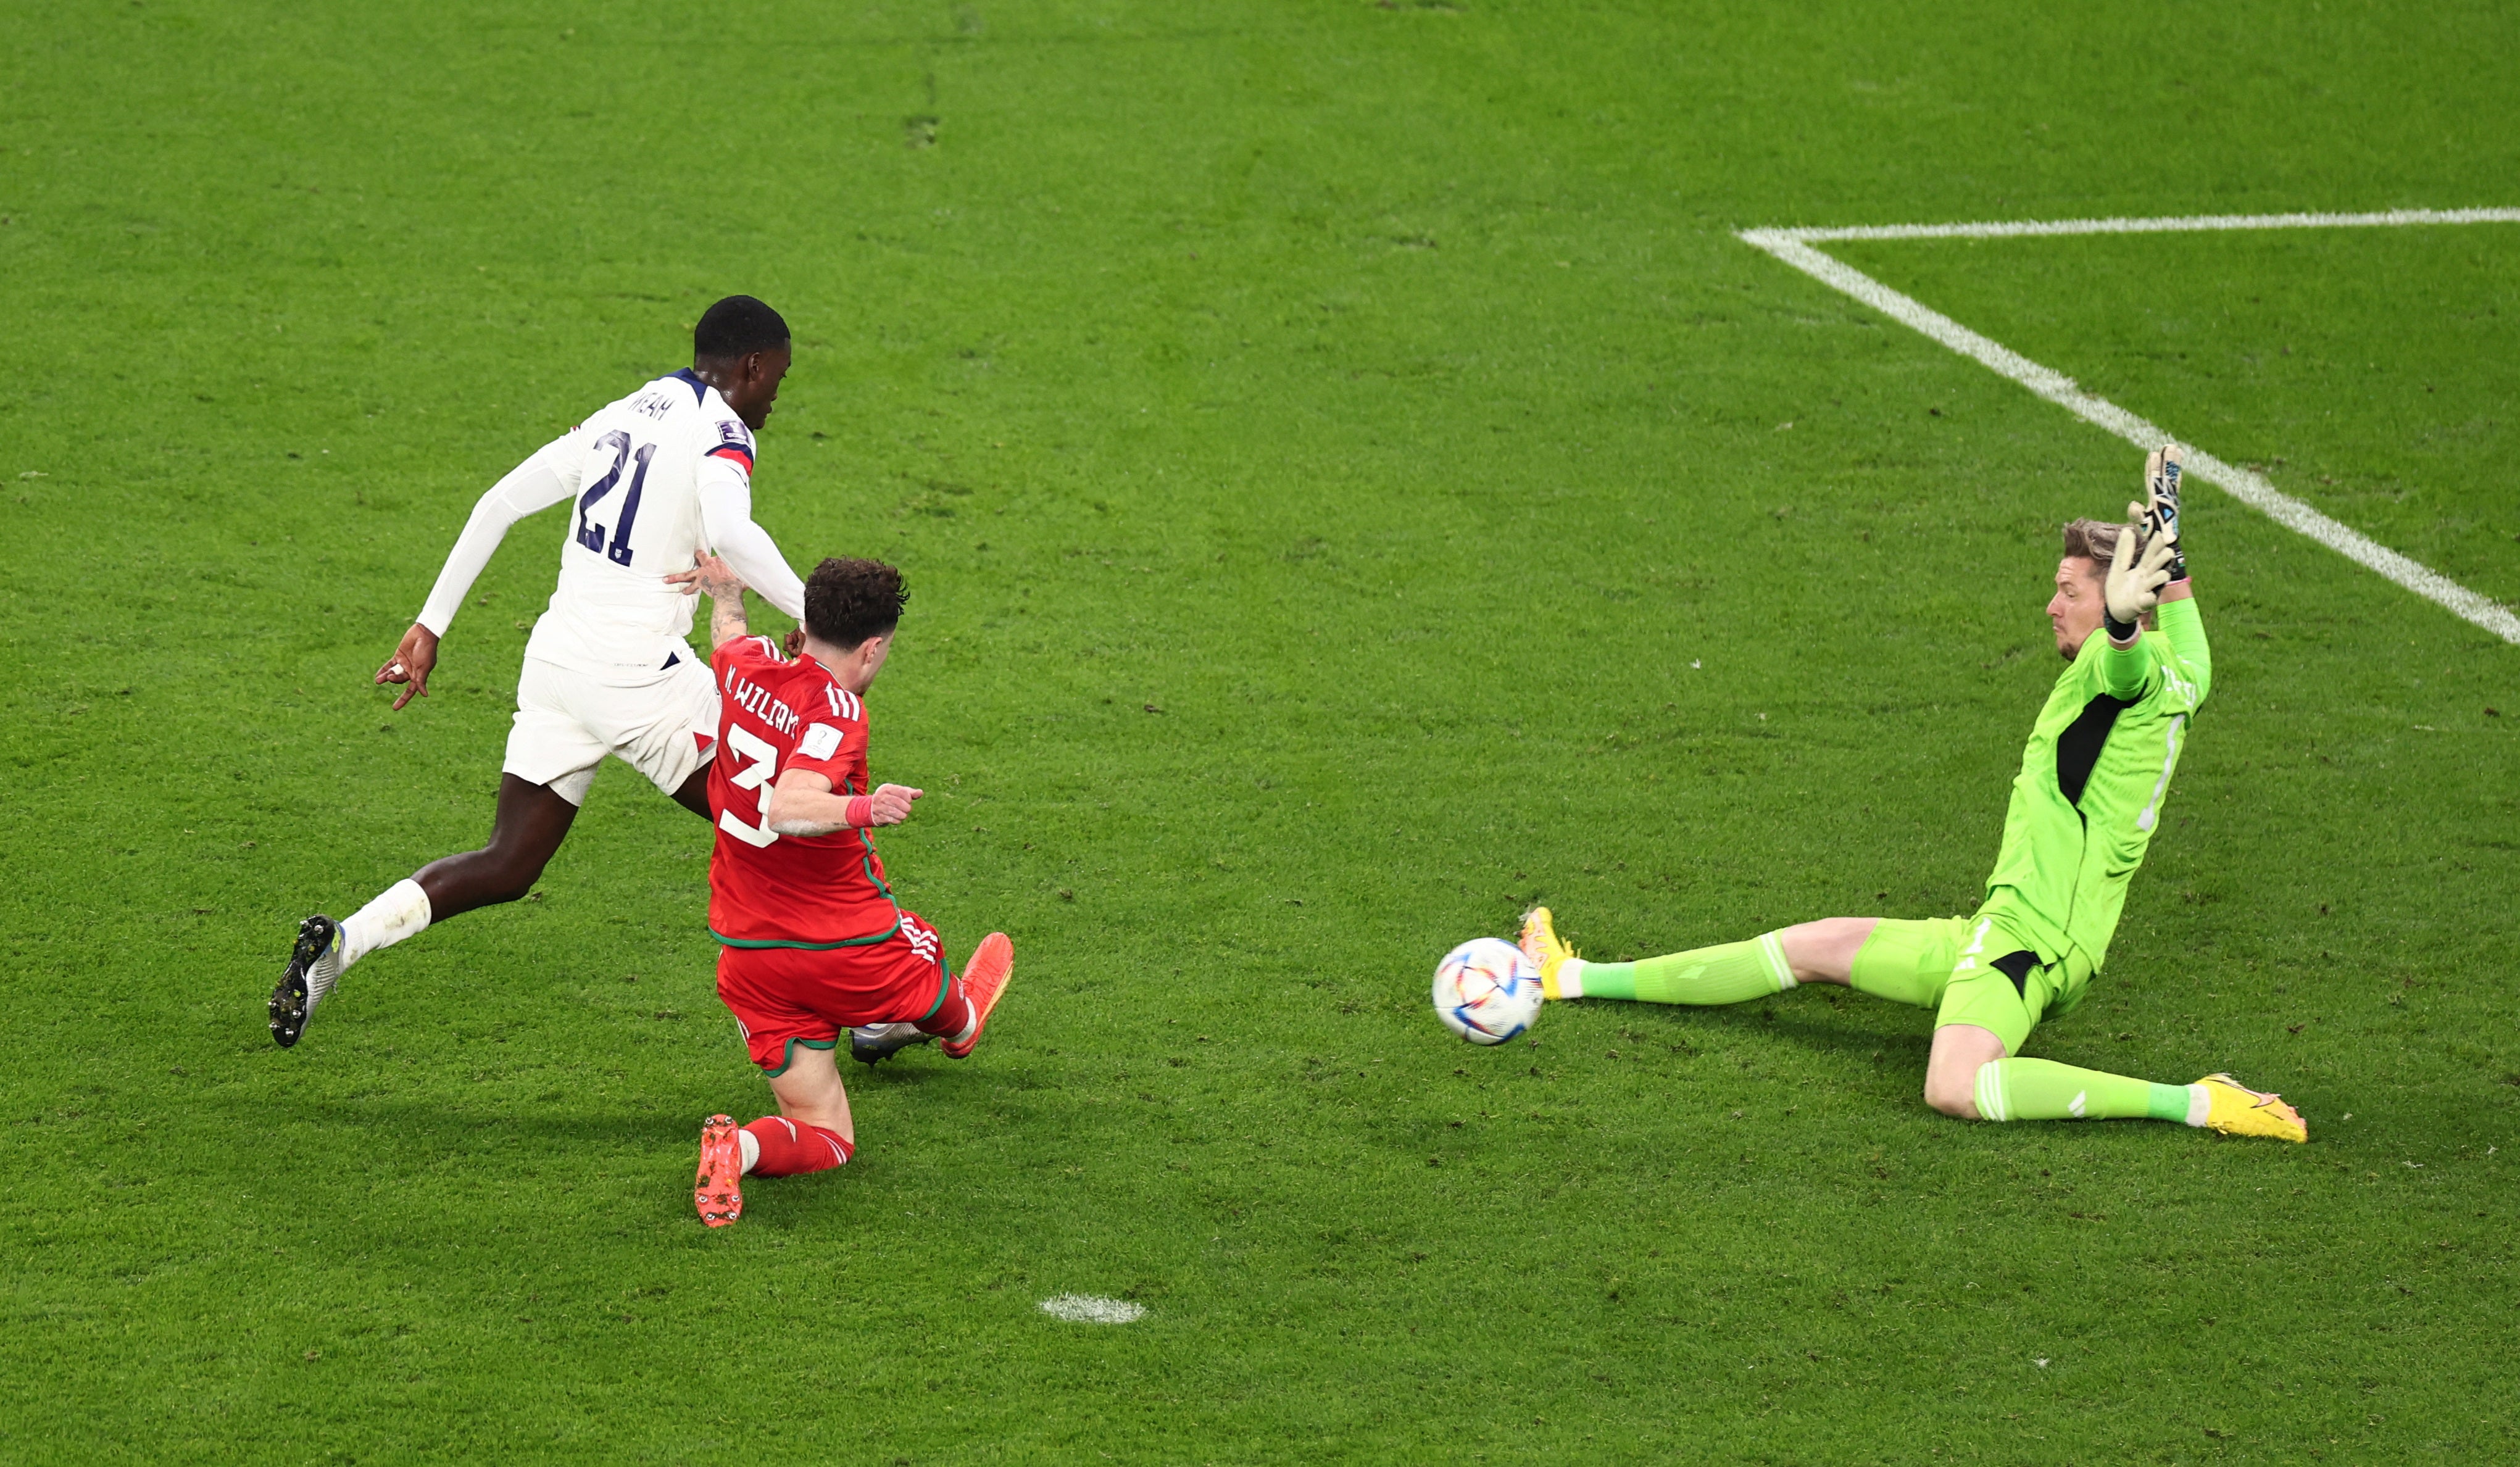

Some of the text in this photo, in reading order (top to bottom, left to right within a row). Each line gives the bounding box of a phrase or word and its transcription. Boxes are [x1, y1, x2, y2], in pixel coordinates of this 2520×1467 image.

[576, 429, 657, 567] 21
[725, 663, 737, 695] N.
[718, 722, 780, 849] 3
